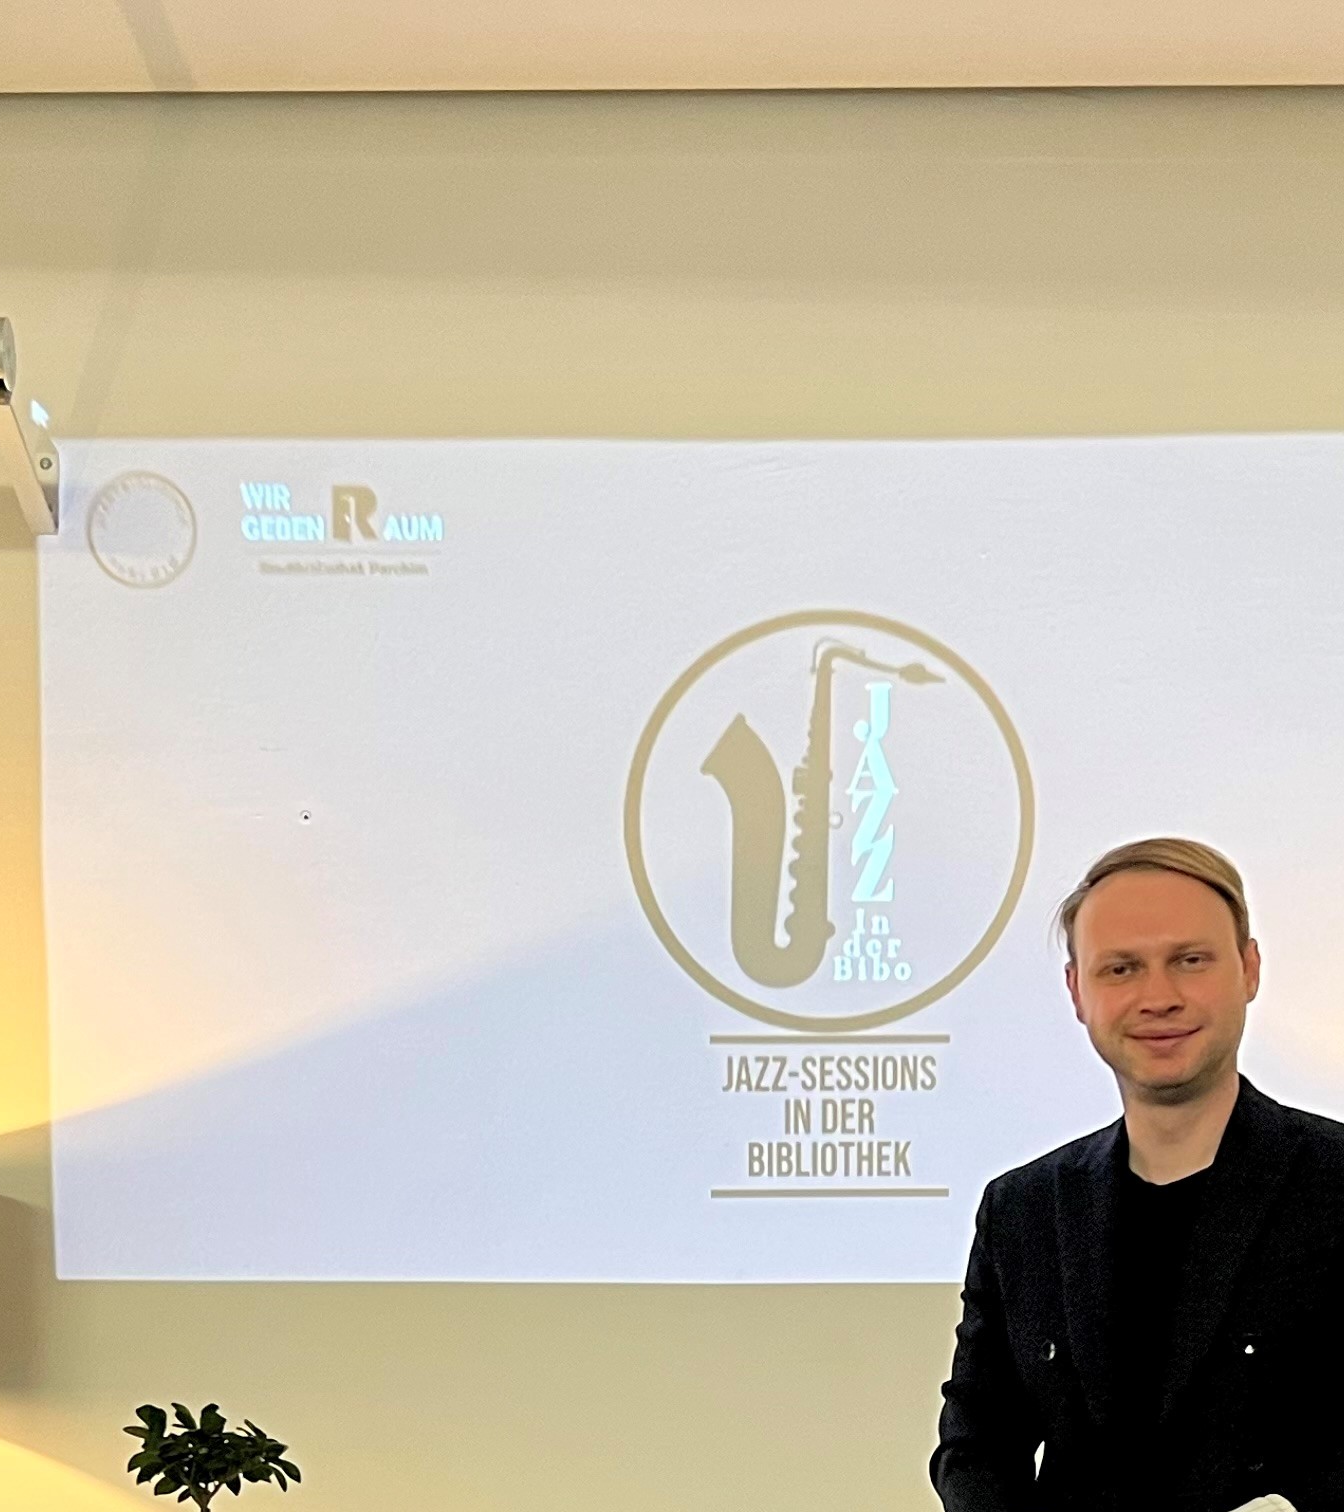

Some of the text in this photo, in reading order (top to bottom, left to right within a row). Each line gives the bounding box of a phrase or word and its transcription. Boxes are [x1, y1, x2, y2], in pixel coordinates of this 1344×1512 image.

[239, 481, 291, 510] WIR
[845, 682, 899, 902] JAZZ
[843, 930, 902, 958] der
[832, 954, 912, 981] Bibo
[722, 1056, 937, 1091] JAZZ-SESSIONS
[784, 1099, 875, 1134] IN DER
[747, 1141, 911, 1176] BIBLIOTHEK
